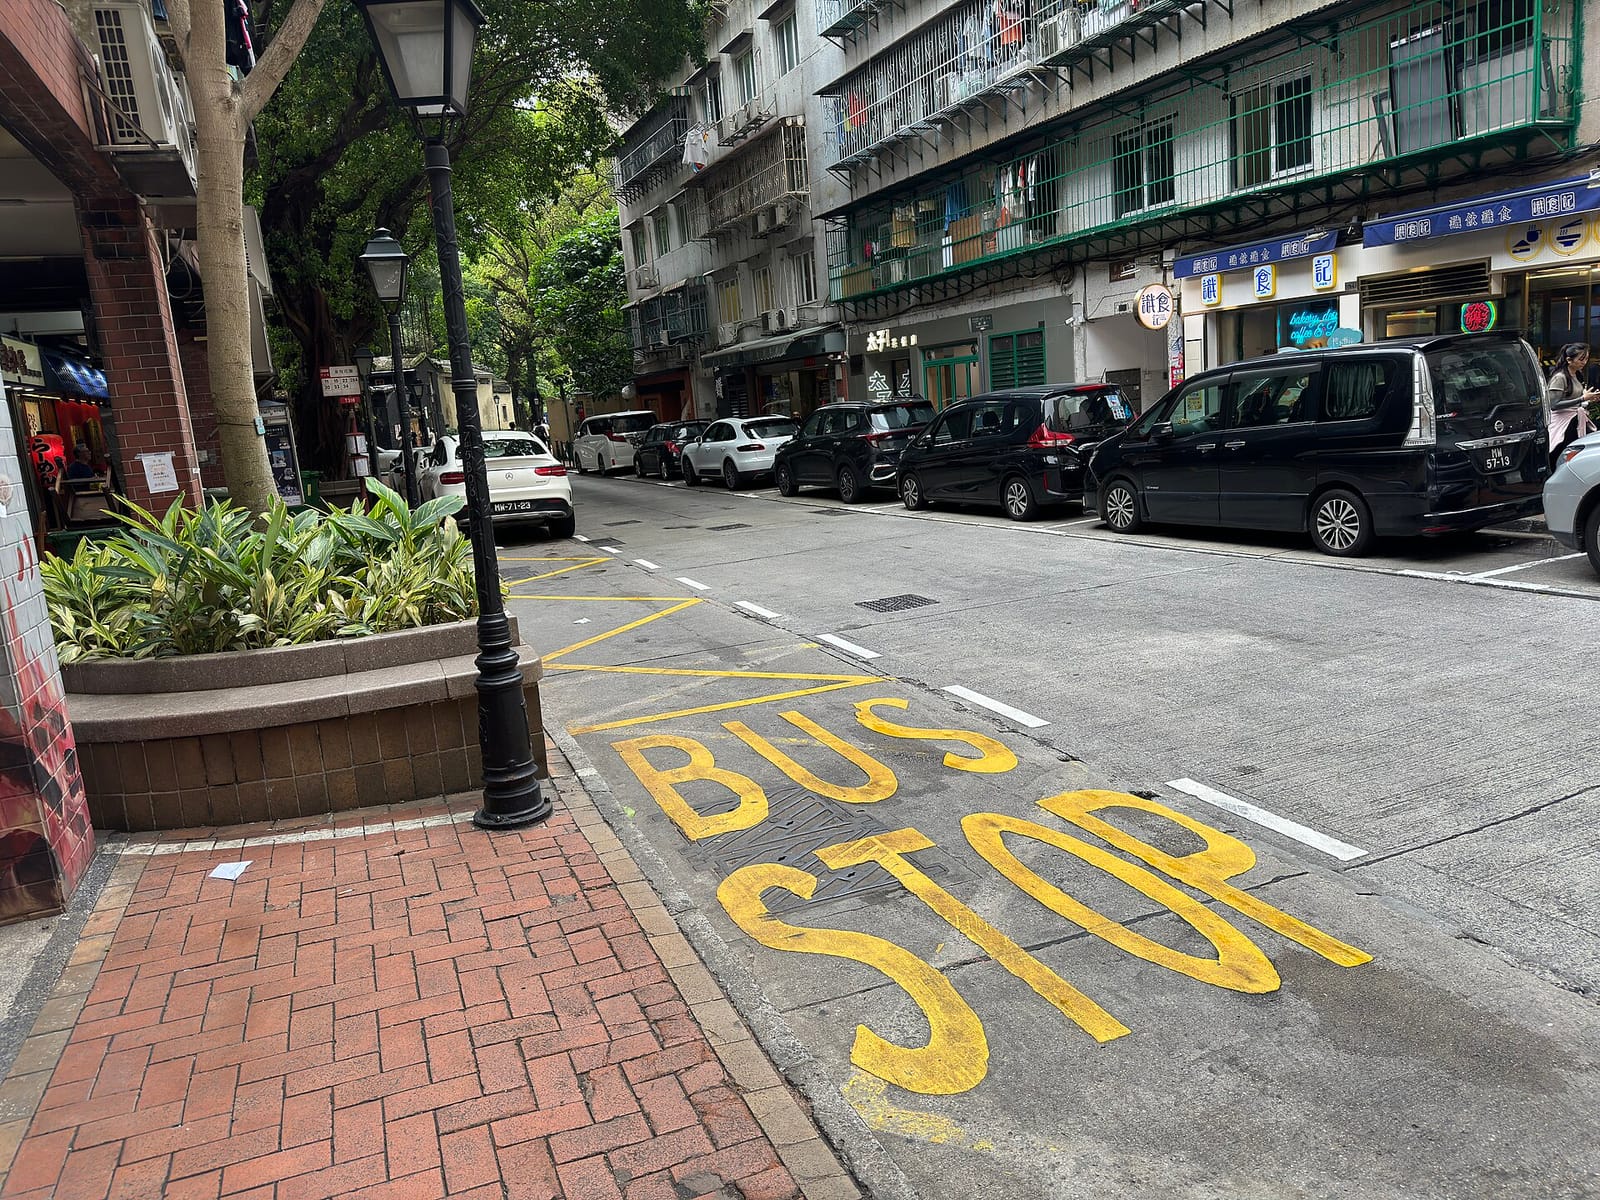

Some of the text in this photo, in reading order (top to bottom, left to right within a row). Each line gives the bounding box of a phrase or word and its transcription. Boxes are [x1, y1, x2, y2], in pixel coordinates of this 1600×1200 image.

[1291, 326, 1313, 344] coffee
[1486, 456, 1510, 469] 57-13
[494, 501, 531, 512] MW-71-23
[611, 697, 1018, 842] BUS
[717, 788, 1373, 1095] STOP
